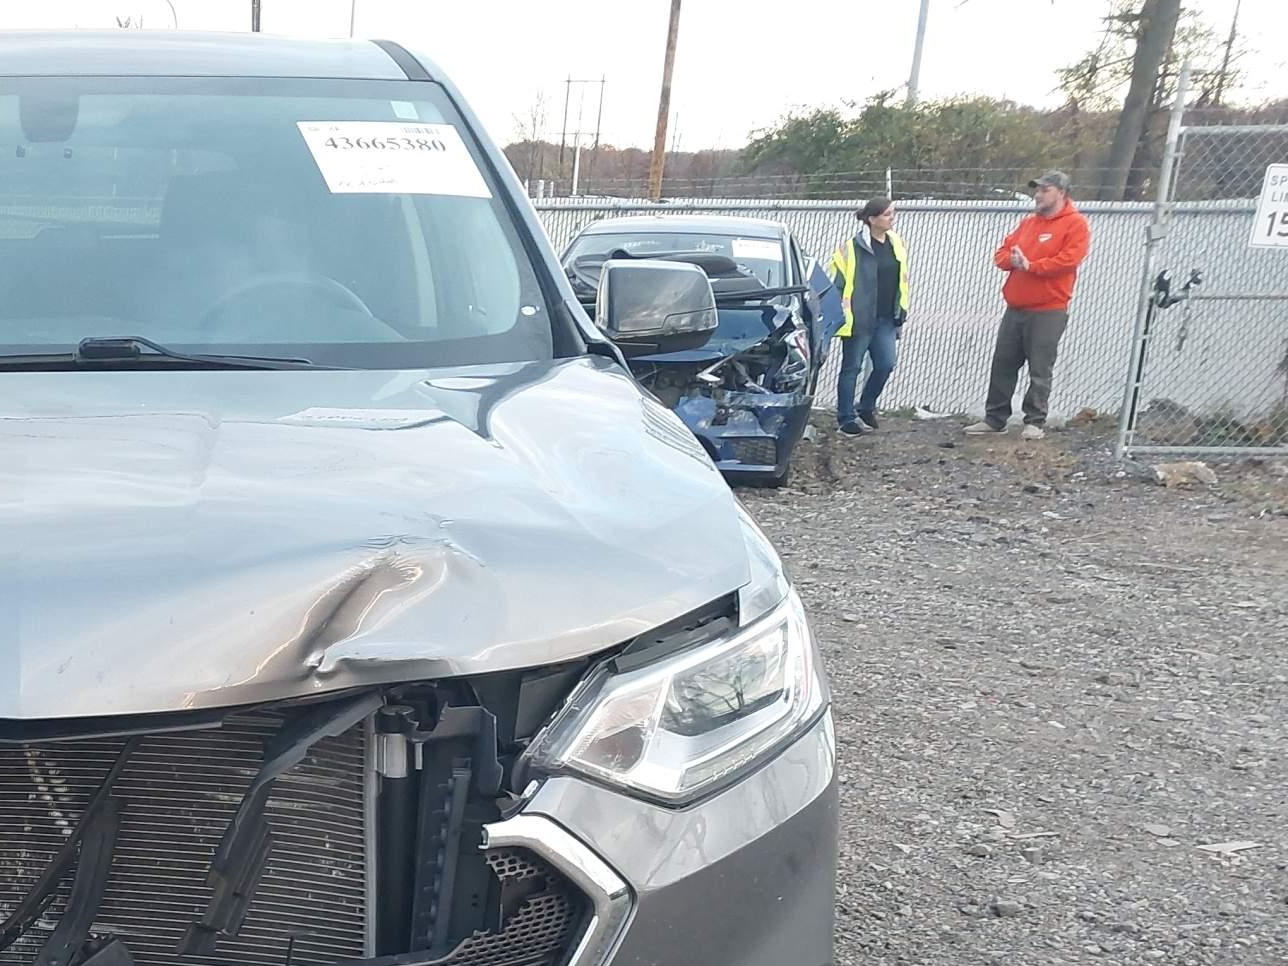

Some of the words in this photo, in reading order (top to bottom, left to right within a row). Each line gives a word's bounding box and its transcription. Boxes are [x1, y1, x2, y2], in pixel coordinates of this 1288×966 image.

[324, 136, 447, 152] 43665380
[1269, 175, 1288, 186] SP
[1266, 211, 1288, 237] 15
